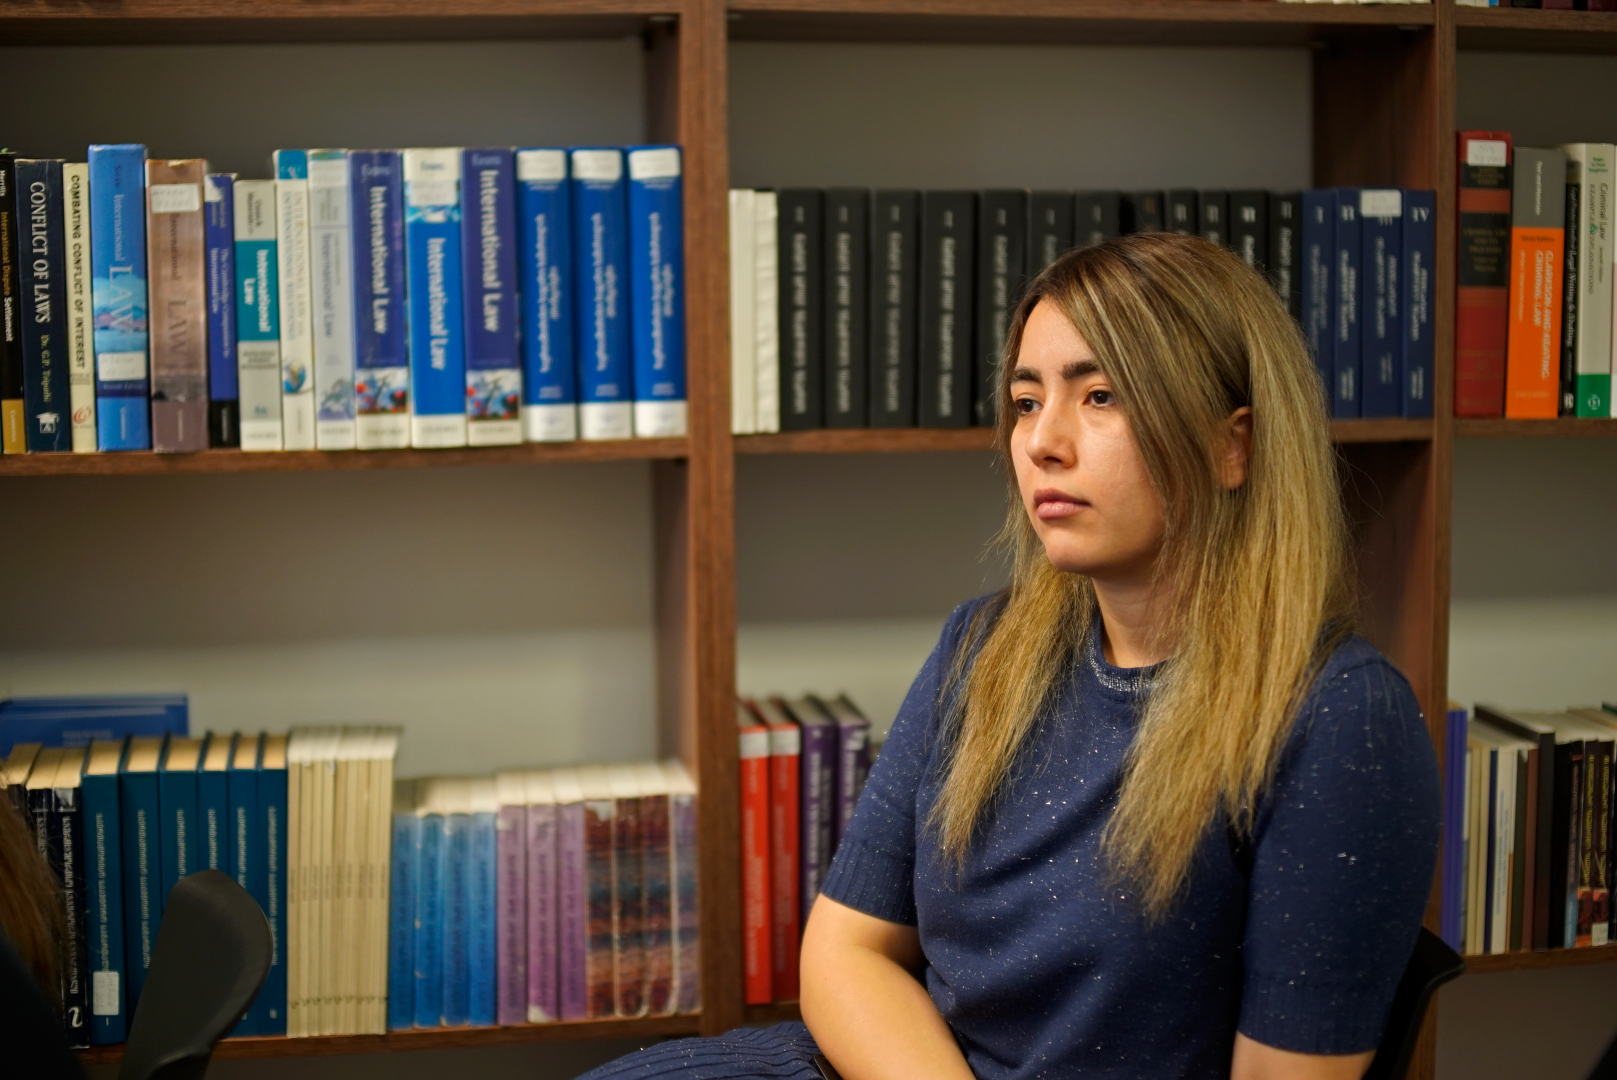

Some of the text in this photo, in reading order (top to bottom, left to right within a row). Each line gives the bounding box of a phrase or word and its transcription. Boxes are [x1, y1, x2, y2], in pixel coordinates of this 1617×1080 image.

[361, 165, 392, 176] Evans
[420, 162, 444, 171] Evans
[71, 175, 82, 239] COMBATING
[112, 194, 125, 261] International
[1413, 206, 1430, 222] IV
[1600, 183, 1608, 220] Criminal
[30, 181, 51, 323] CONFLICT OF LAWS
[170, 214, 181, 280] International
[220, 248, 229, 261] The
[294, 190, 306, 289] INTERNATIONAL
[480, 170, 502, 332] International Law
[1590, 225, 1598, 233] &
[1, 212, 14, 341] International Dispute Settlement
[72, 242, 84, 296] CONFLICT
[210, 248, 220, 313] International Law
[218, 263, 229, 300] Cambridge
[284, 190, 296, 340] INTERNATIONAL RELATIONS
[321, 233, 334, 311] International
[370, 186, 393, 333] International Law
[1545, 250, 1554, 307] CLARKSON
[1568, 251, 1577, 271] Legal
[74, 299, 84, 313] OF
[109, 265, 133, 334] LAW
[244, 278, 256, 305] Law
[256, 250, 271, 332] International
[296, 294, 307, 318] LAW
[427, 238, 446, 370] International Law
[1534, 250, 1544, 326] CRIMINAL LAW
[1567, 273, 1576, 302] Writing
[1569, 304, 1575, 312] &
[40, 334, 51, 349] Dr.
[74, 317, 86, 369] INTEREST
[167, 300, 187, 355] LAW
[219, 303, 231, 345] Companion
[323, 314, 334, 338] Law
[1566, 313, 1575, 347] Drafting
[41, 350, 51, 368] G.P.
